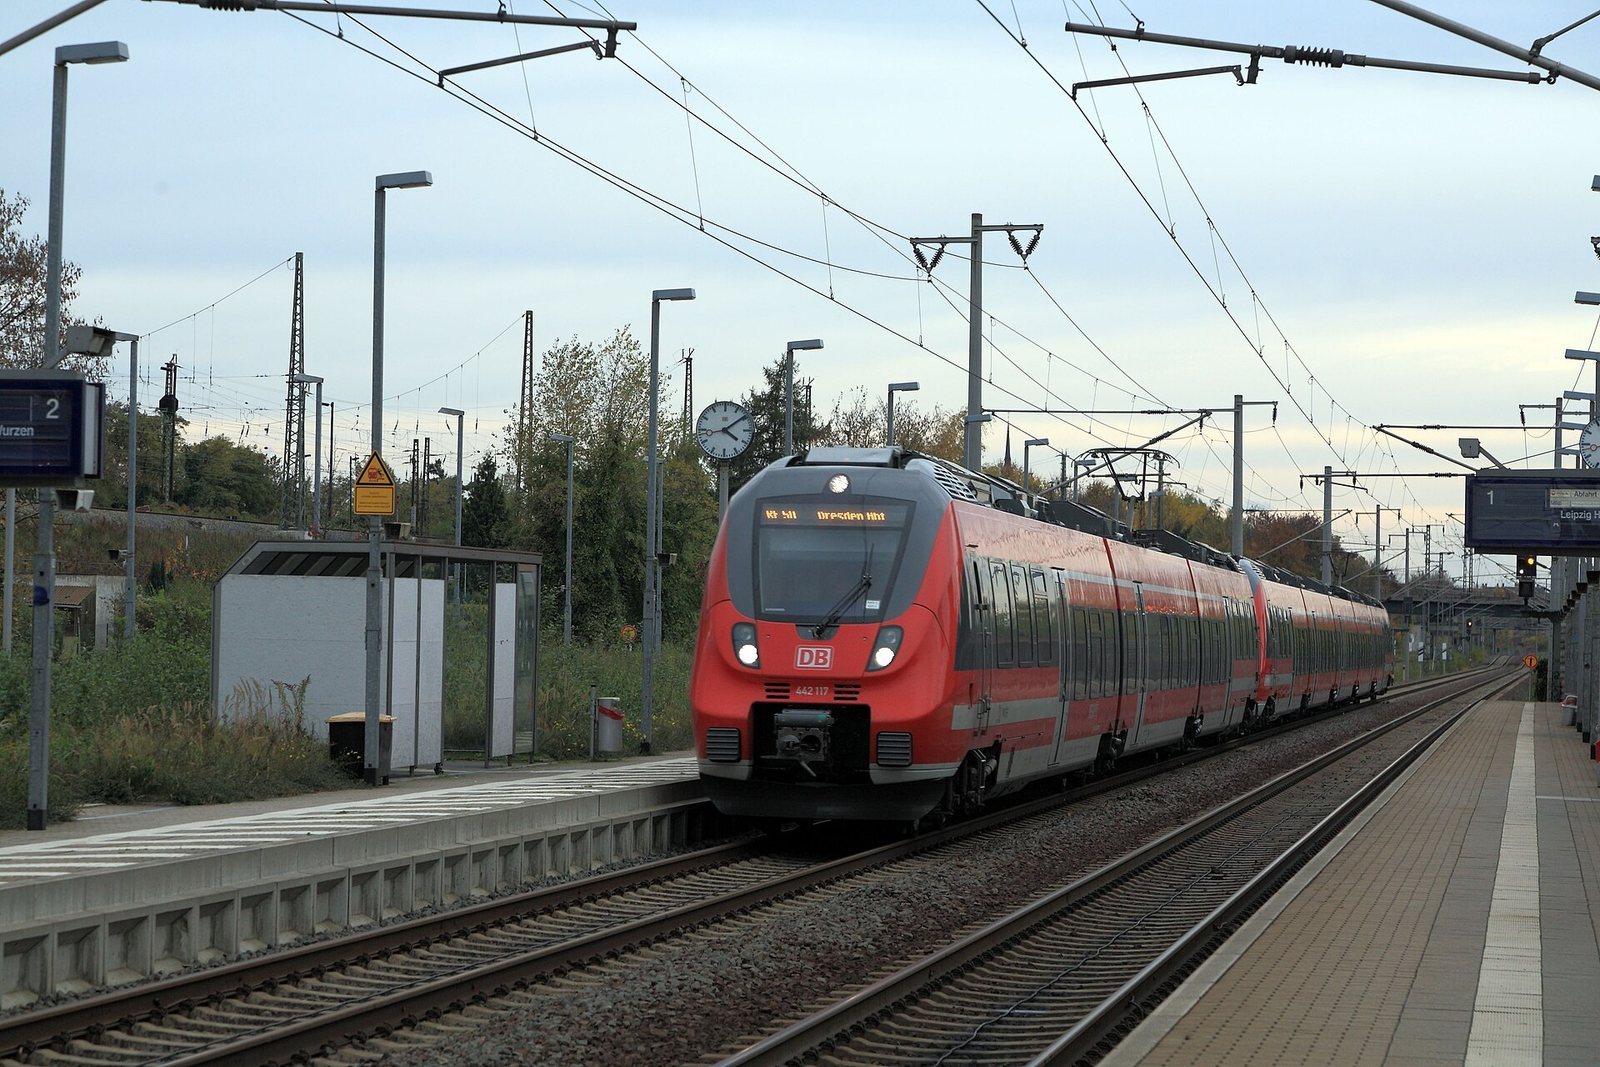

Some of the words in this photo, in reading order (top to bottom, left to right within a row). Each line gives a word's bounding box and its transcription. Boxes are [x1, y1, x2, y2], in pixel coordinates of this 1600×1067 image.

[46, 398, 59, 419] 2
[0, 424, 34, 437] urzen
[1486, 489, 1494, 505] 1
[1560, 509, 1592, 521] Leipzig
[798, 648, 831, 667] DB
[796, 686, 814, 696] 442
[815, 686, 829, 696] 117
